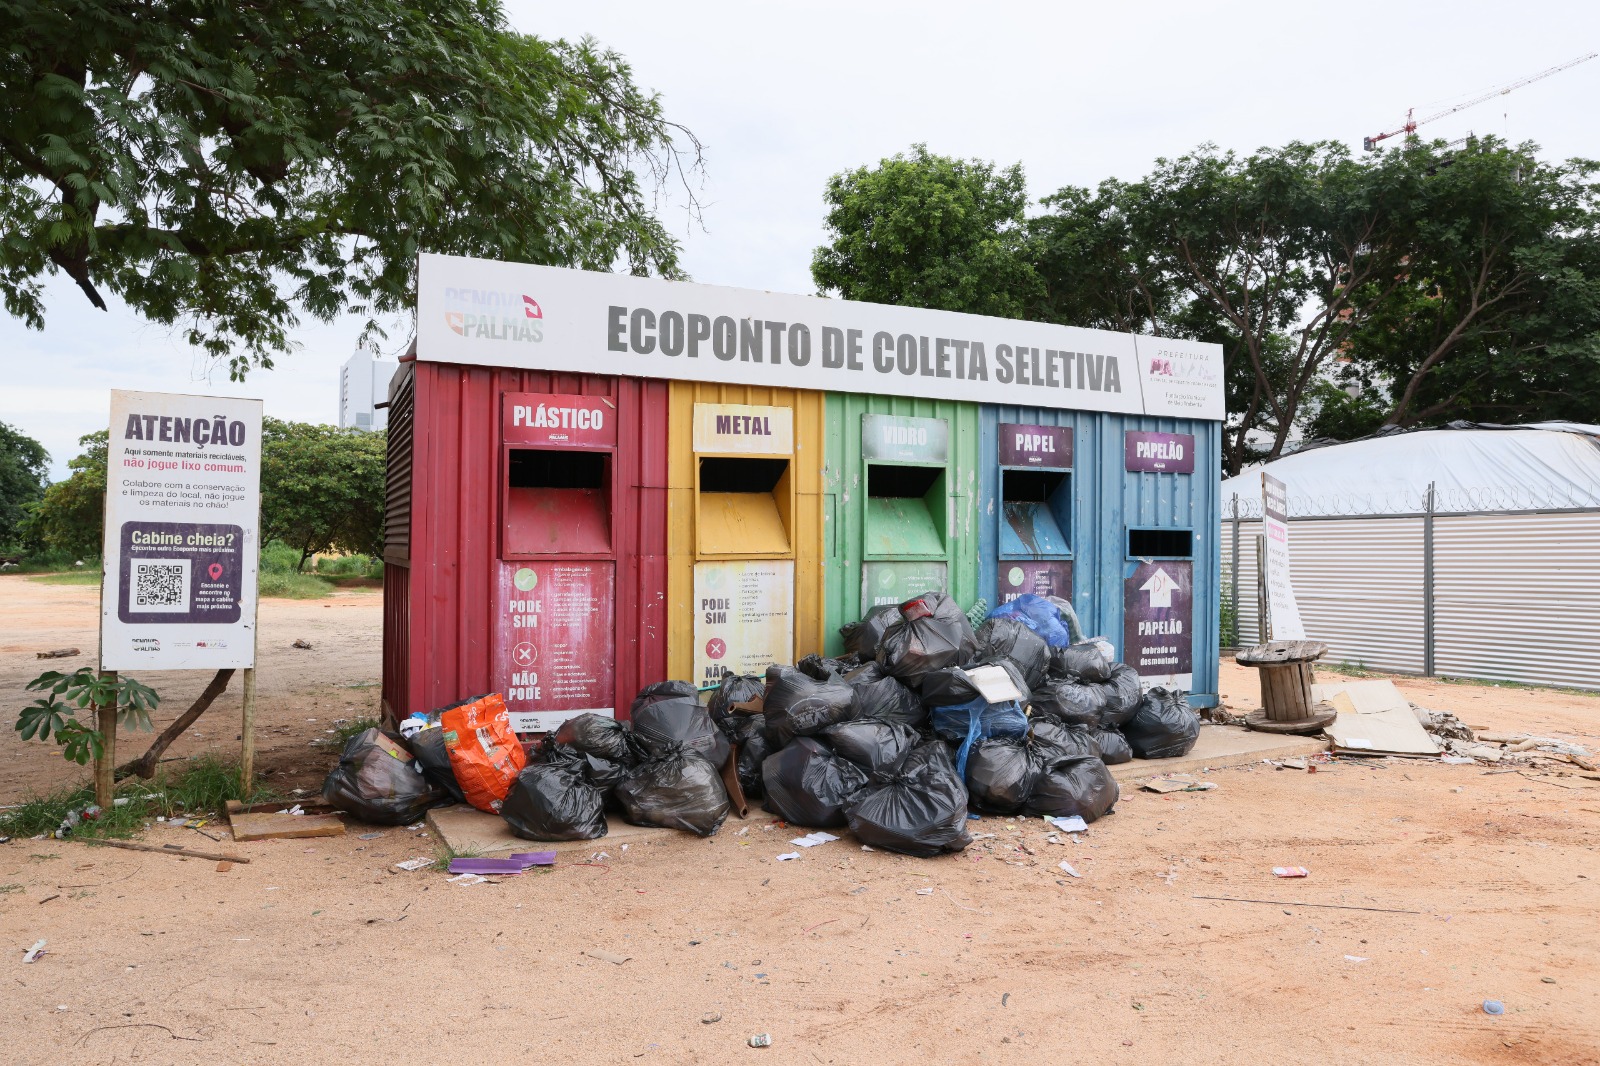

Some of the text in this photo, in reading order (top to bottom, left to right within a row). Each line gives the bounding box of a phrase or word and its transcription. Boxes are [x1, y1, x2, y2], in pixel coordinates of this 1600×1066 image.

[464, 313, 543, 343] PALMAS
[608, 306, 1121, 393] ECOPONTO DE COLETA SELETIVA
[1158, 349, 1209, 361] PREFEITURA
[514, 403, 603, 430] PLÁSTICO
[125, 414, 246, 449] ATENÇÃO
[717, 415, 771, 435] METAL
[883, 426, 927, 445] VIDRO
[1016, 434, 1056, 452] PAPEL
[124, 448, 247, 462] Aqui somente materiais recicláveis,
[1137, 441, 1184, 460] PAPELÃO
[124, 458, 246, 473] não jogue lixo comum.
[122, 479, 162, 489] Colabore
[193, 484, 245, 493] conservação
[130, 489, 164, 499] limpeza
[166, 490, 178, 498] do
[180, 491, 201, 500] local,
[204, 492, 220, 500] não
[222, 493, 245, 502] jogue
[152, 499, 191, 508] materiais
[206, 501, 229, 509] chão!
[132, 530, 182, 545] Cabine
[186, 533, 235, 546] cheia?
[510, 600, 542, 613] PODE
[702, 598, 730, 610] PODE
[513, 614, 537, 628] SIM
[706, 612, 726, 624] SIM
[1139, 619, 1182, 636] PAPELÃO
[1142, 646, 1168, 654] dobrado
[1140, 656, 1178, 666] desmontado
[512, 671, 537, 685] NÃO
[706, 664, 727, 678] NÃO
[509, 687, 541, 701] PODE
